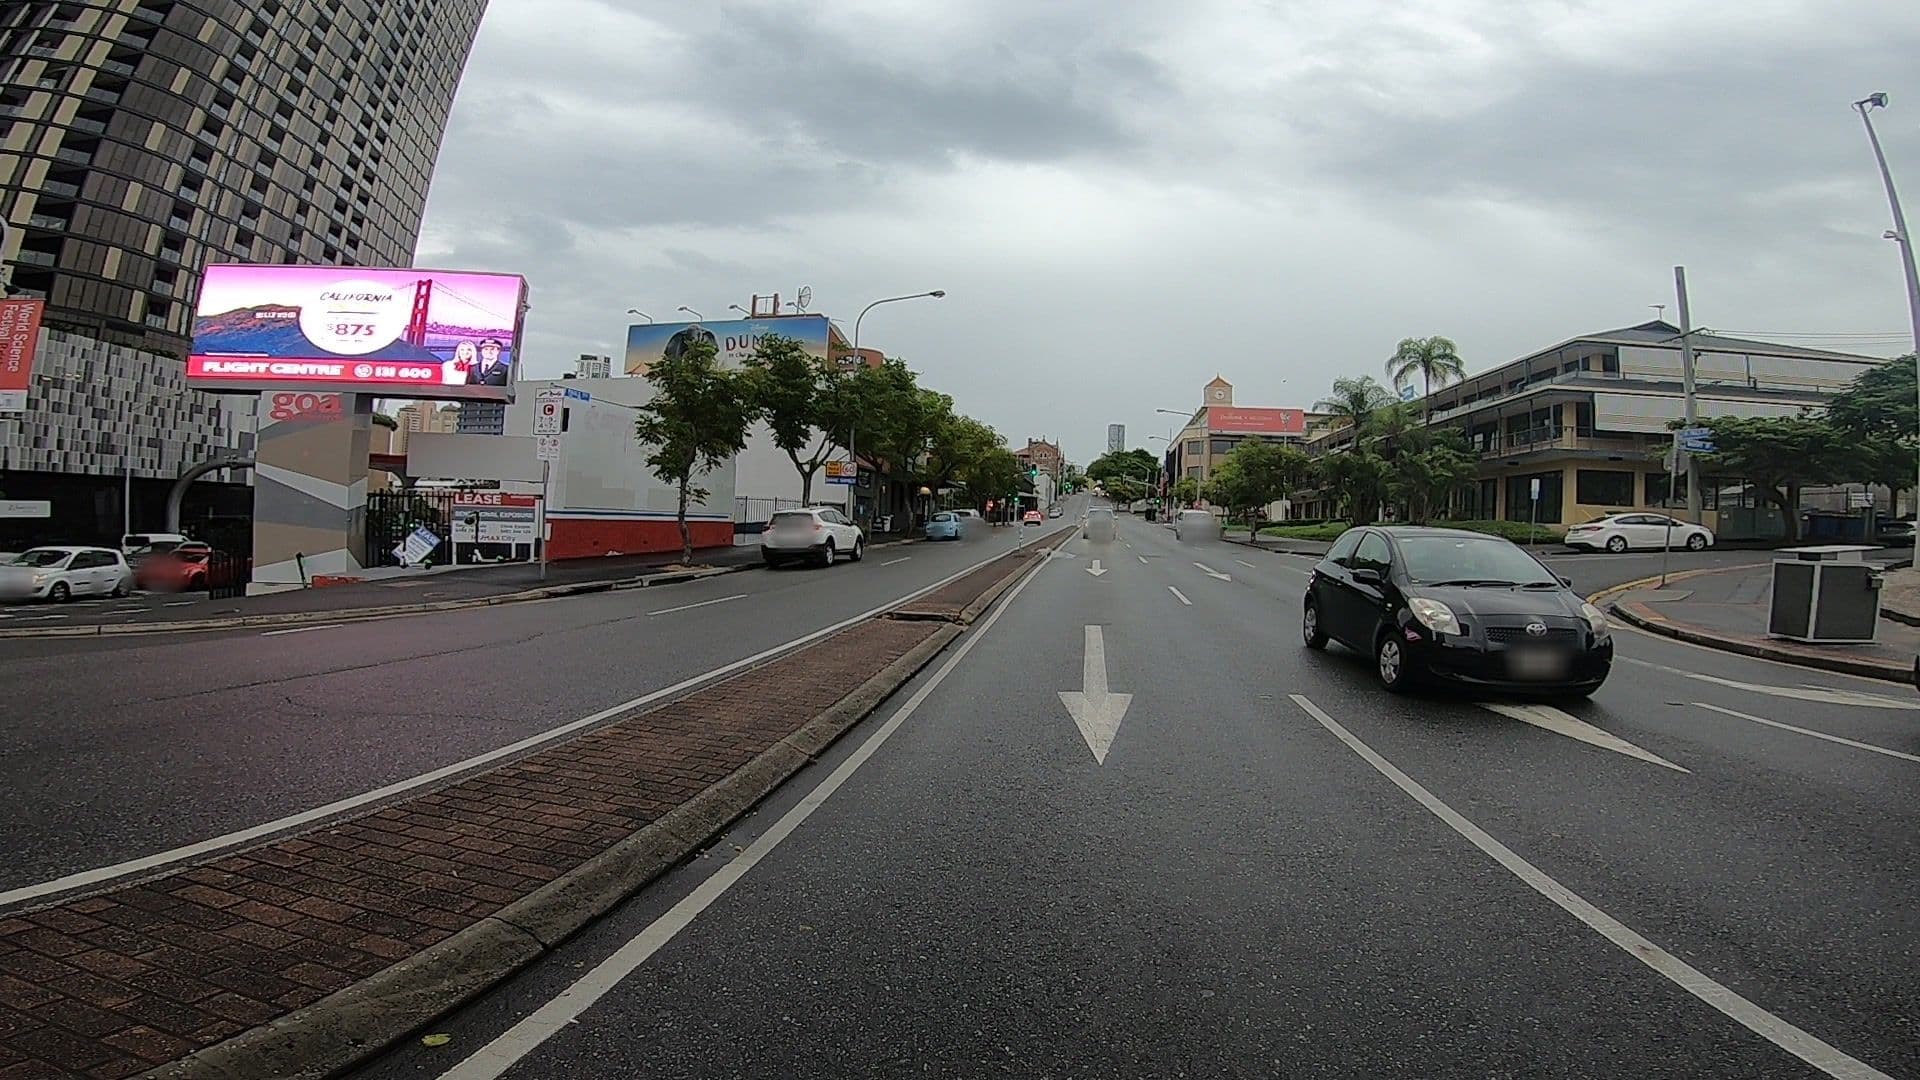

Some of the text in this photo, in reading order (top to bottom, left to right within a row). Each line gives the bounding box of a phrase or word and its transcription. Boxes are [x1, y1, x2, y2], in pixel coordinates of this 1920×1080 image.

[319, 292, 392, 302] CALIFORNIA
[15, 303, 36, 332] World
[7, 333, 29, 372] Science
[203, 361, 270, 374] FLIGHT
[270, 363, 344, 376] CENTRE
[270, 393, 342, 420] goa
[455, 493, 502, 505] LEASE
